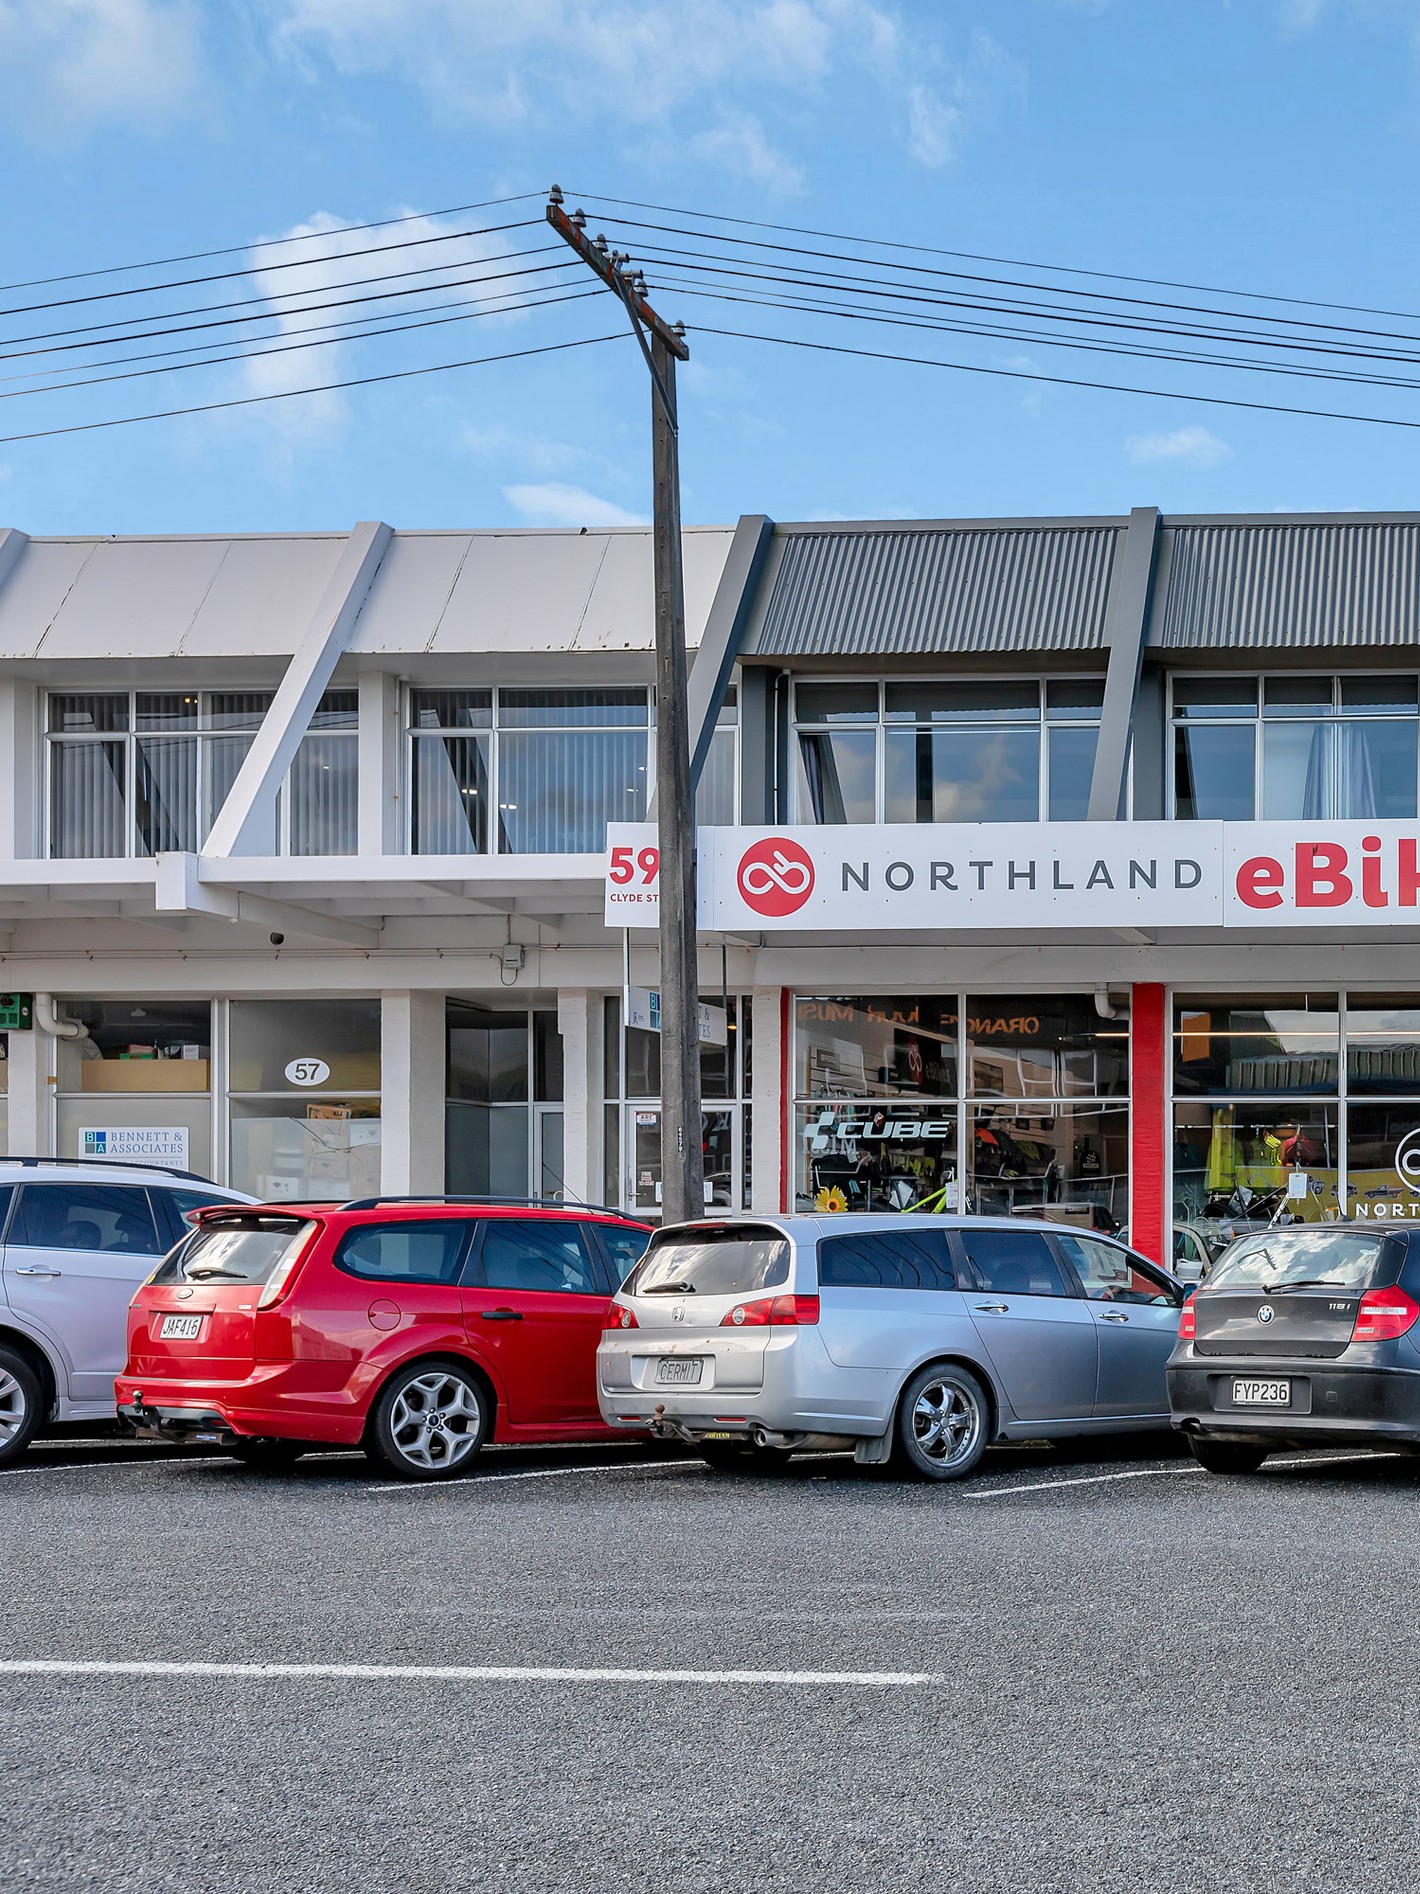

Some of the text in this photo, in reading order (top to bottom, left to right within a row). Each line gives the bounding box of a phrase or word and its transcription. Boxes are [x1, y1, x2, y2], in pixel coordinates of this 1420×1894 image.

[610, 847, 660, 884] 59
[842, 859, 1203, 892] NORTHLAND
[610, 894, 659, 902] CLYDE ST
[295, 1063, 320, 1080] 57
[86, 1132, 94, 1142] B
[111, 1132, 182, 1142] BENNETT &
[836, 1121, 950, 1138] CUBE
[97, 1144, 105, 1153] A
[110, 1144, 183, 1154] ASSOCIATES
[163, 1320, 198, 1336] JAF416
[660, 1364, 698, 1380] CERMIT
[1234, 1383, 1288, 1400] FYP236
